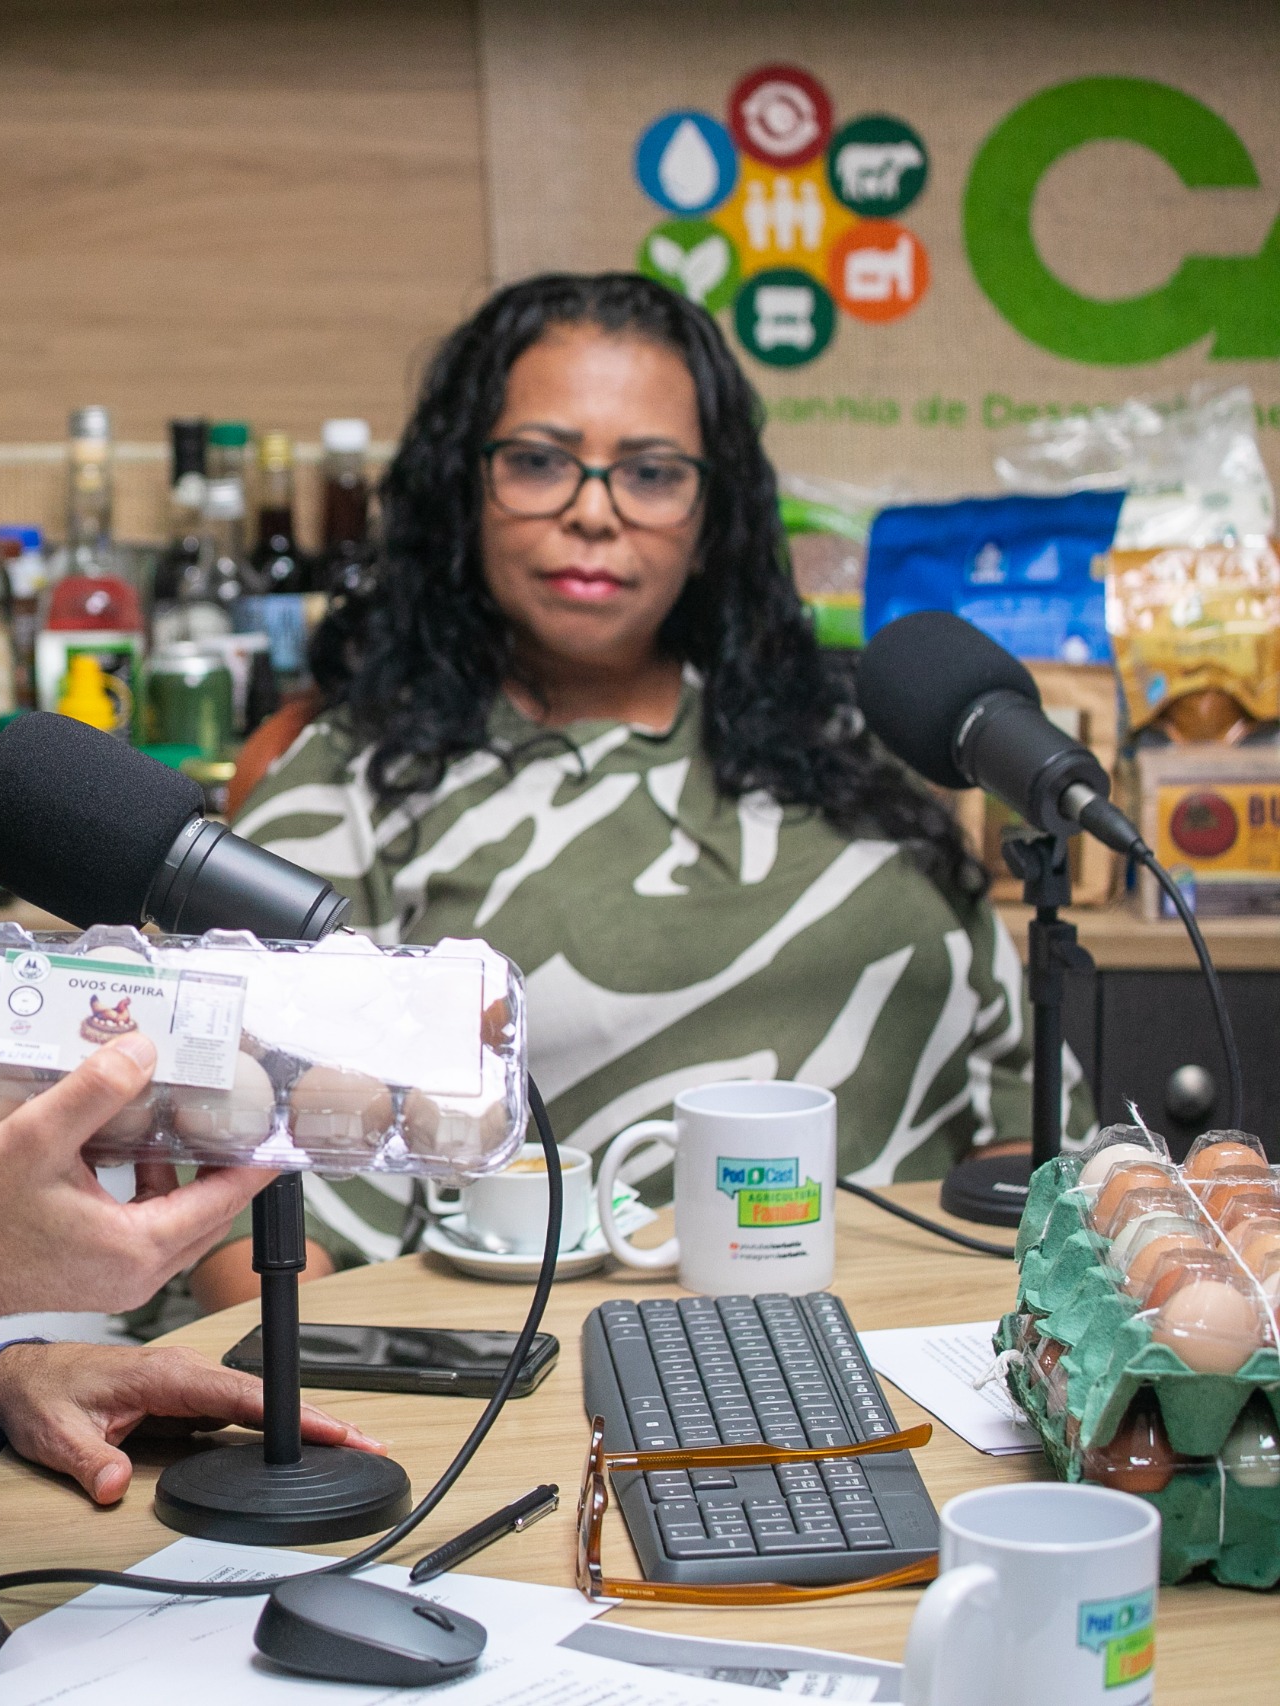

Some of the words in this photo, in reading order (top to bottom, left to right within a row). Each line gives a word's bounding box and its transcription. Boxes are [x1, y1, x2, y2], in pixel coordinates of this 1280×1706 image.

[913, 393, 969, 428] de
[68, 977, 107, 992] OVOS
[110, 982, 165, 998] CAIPIRA
[722, 1166, 745, 1184] Pod
